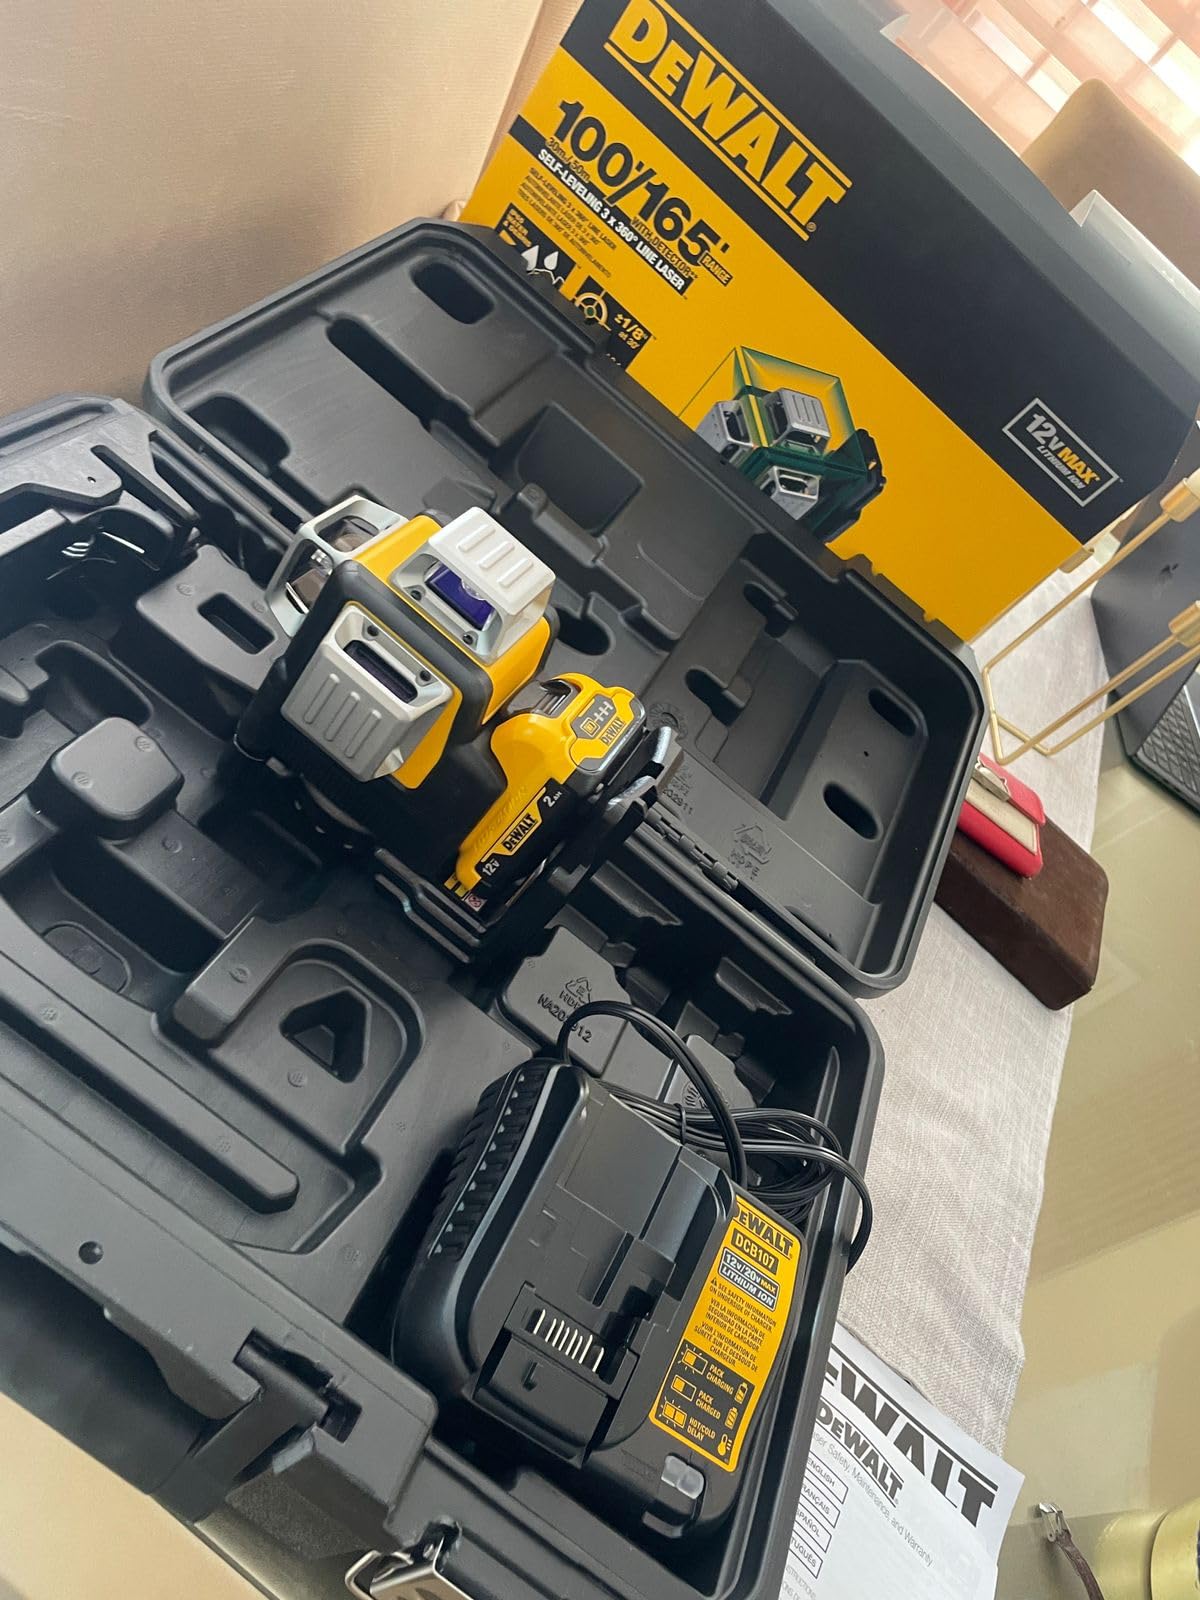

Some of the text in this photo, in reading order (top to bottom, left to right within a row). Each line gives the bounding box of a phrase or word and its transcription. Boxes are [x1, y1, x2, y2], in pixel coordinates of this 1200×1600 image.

[538, 149, 603, 213] SELF-LEVELING
[600, 208, 610, 219] 3
[635, 241, 656, 264] LINE
[655, 260, 685, 290] LASER
[702, 253, 731, 284] RANGE
[1036, 445, 1072, 476] LITHIUM
[600, 717, 625, 746] DEWALT
[501, 813, 538, 851] DEWALT
[736, 1207, 794, 1257] EWALT
[734, 1232, 775, 1269] DCB107
[721, 1266, 775, 1307] LITHIUM ION
[707, 1371, 734, 1394] CHARGING
[710, 1364, 725, 1378] PACK
[696, 1398, 721, 1419] CHARGED
[699, 1390, 714, 1404] PACK
[687, 1424, 705, 1441] DELAY
[689, 1416, 716, 1439] HOT/COLD
[816, 1401, 904, 1502] DEWALT
[802, 1484, 831, 1515] RANÇAIS
[790, 1536, 817, 1568] TUGUÊS
